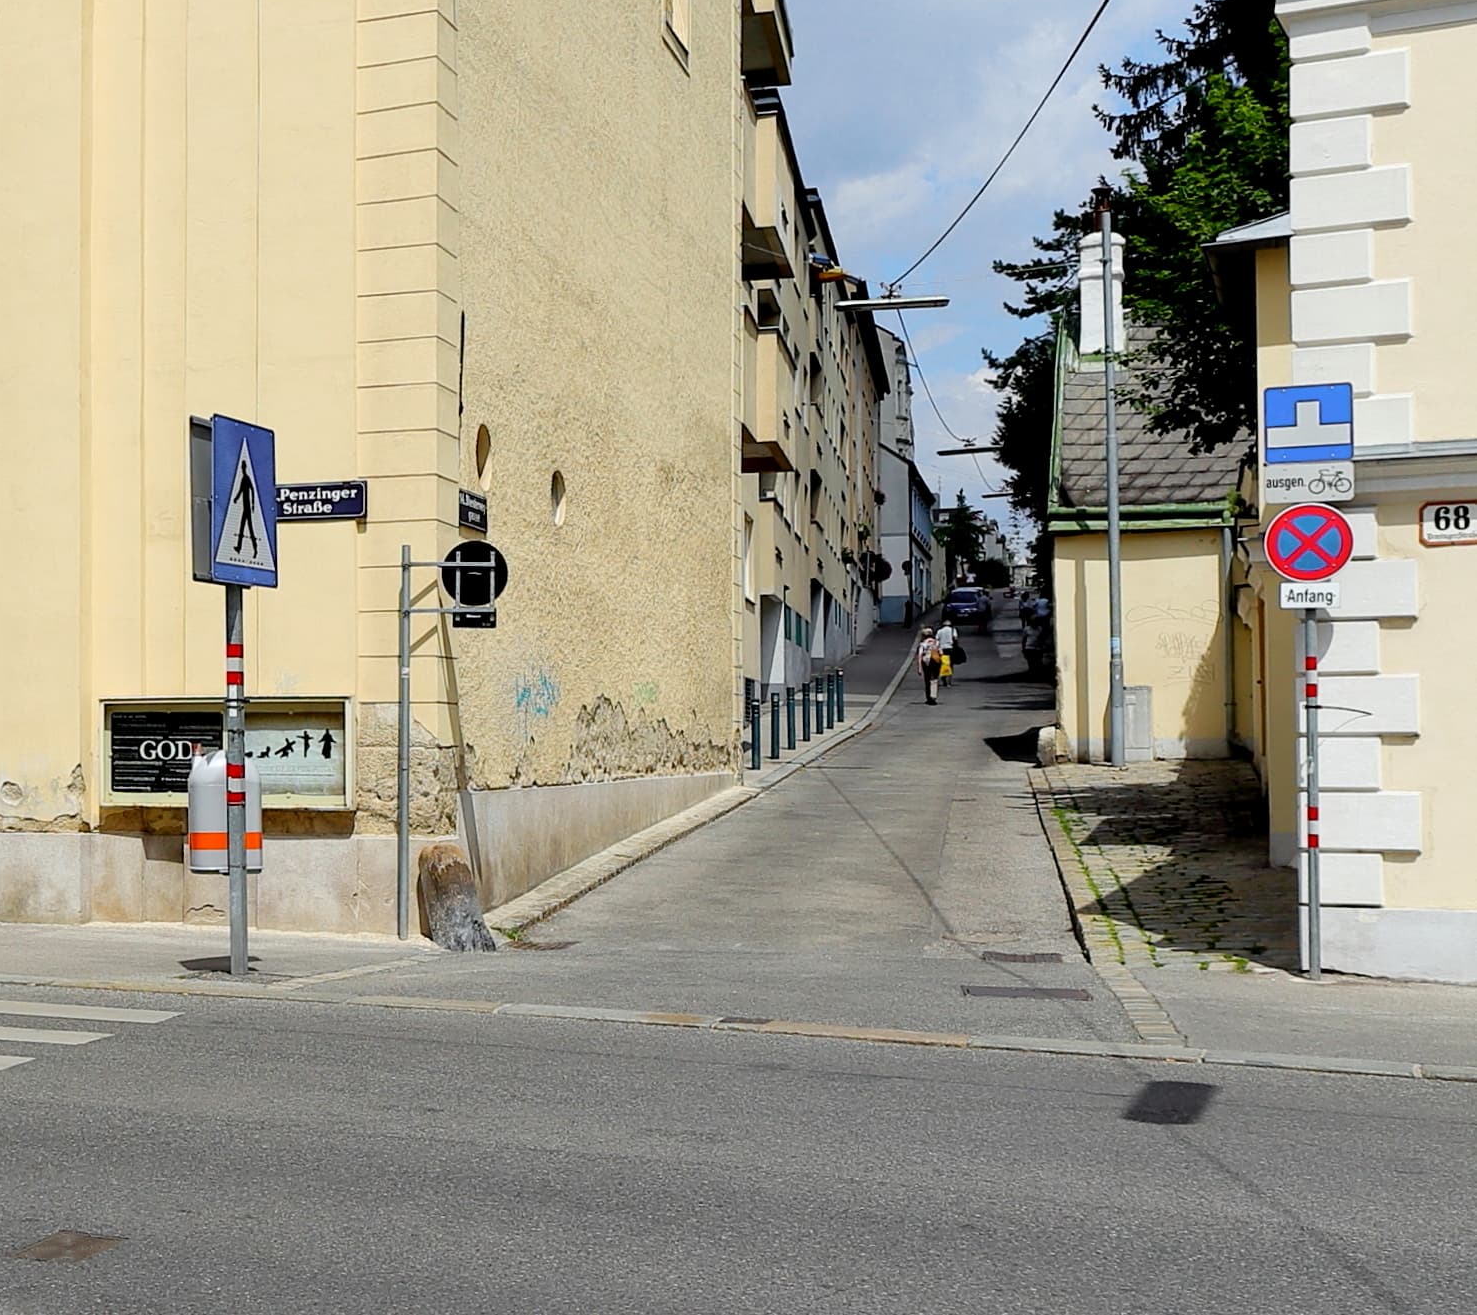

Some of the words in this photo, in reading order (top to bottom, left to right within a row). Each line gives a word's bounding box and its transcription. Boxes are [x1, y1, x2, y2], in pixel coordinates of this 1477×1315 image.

[280, 488, 358, 502] Penzinger
[283, 500, 333, 514] Straße
[1434, 505, 1471, 531] 68
[1287, 587, 1334, 606] Anfang
[139, 740, 193, 761] GOD
